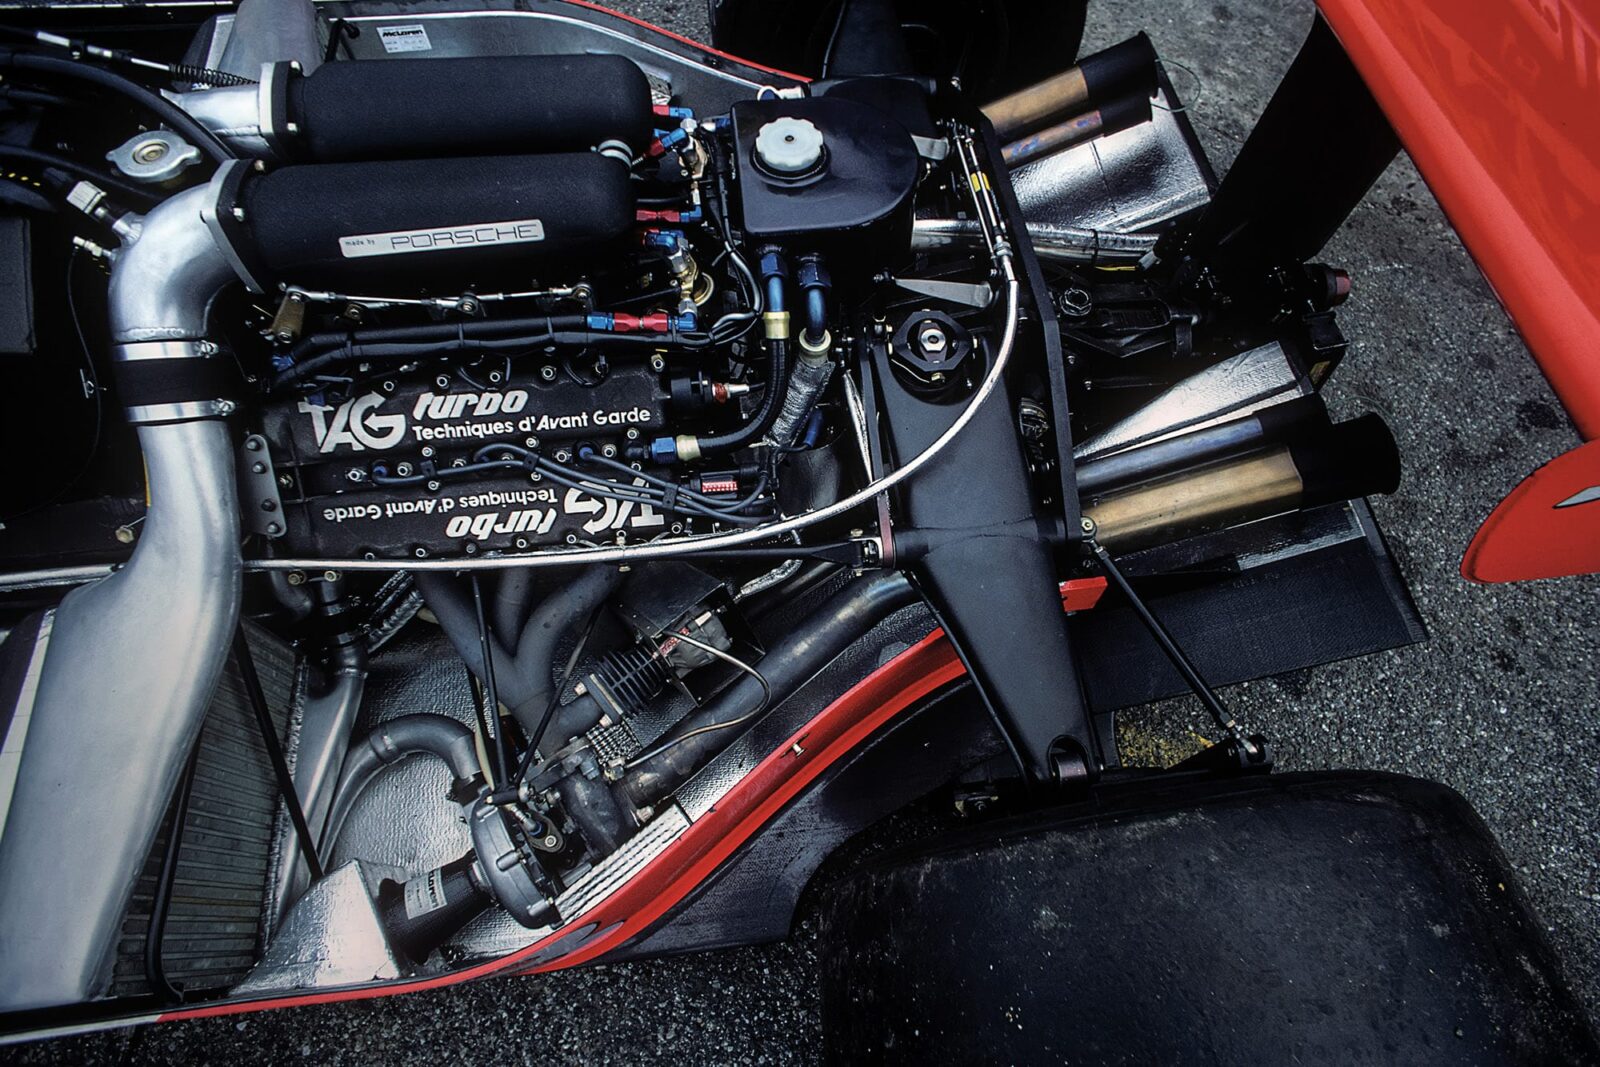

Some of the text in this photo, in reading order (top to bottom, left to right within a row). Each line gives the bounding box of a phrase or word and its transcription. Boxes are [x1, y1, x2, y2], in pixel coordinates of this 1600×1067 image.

[366, 238, 375, 246] by
[391, 224, 538, 249] PORSCHE
[297, 390, 406, 453] TAG
[412, 407, 651, 441] Techniques d'Avant Garde
[323, 488, 558, 522] Techniques d'Avant Garde
[445, 507, 557, 540] turbo
